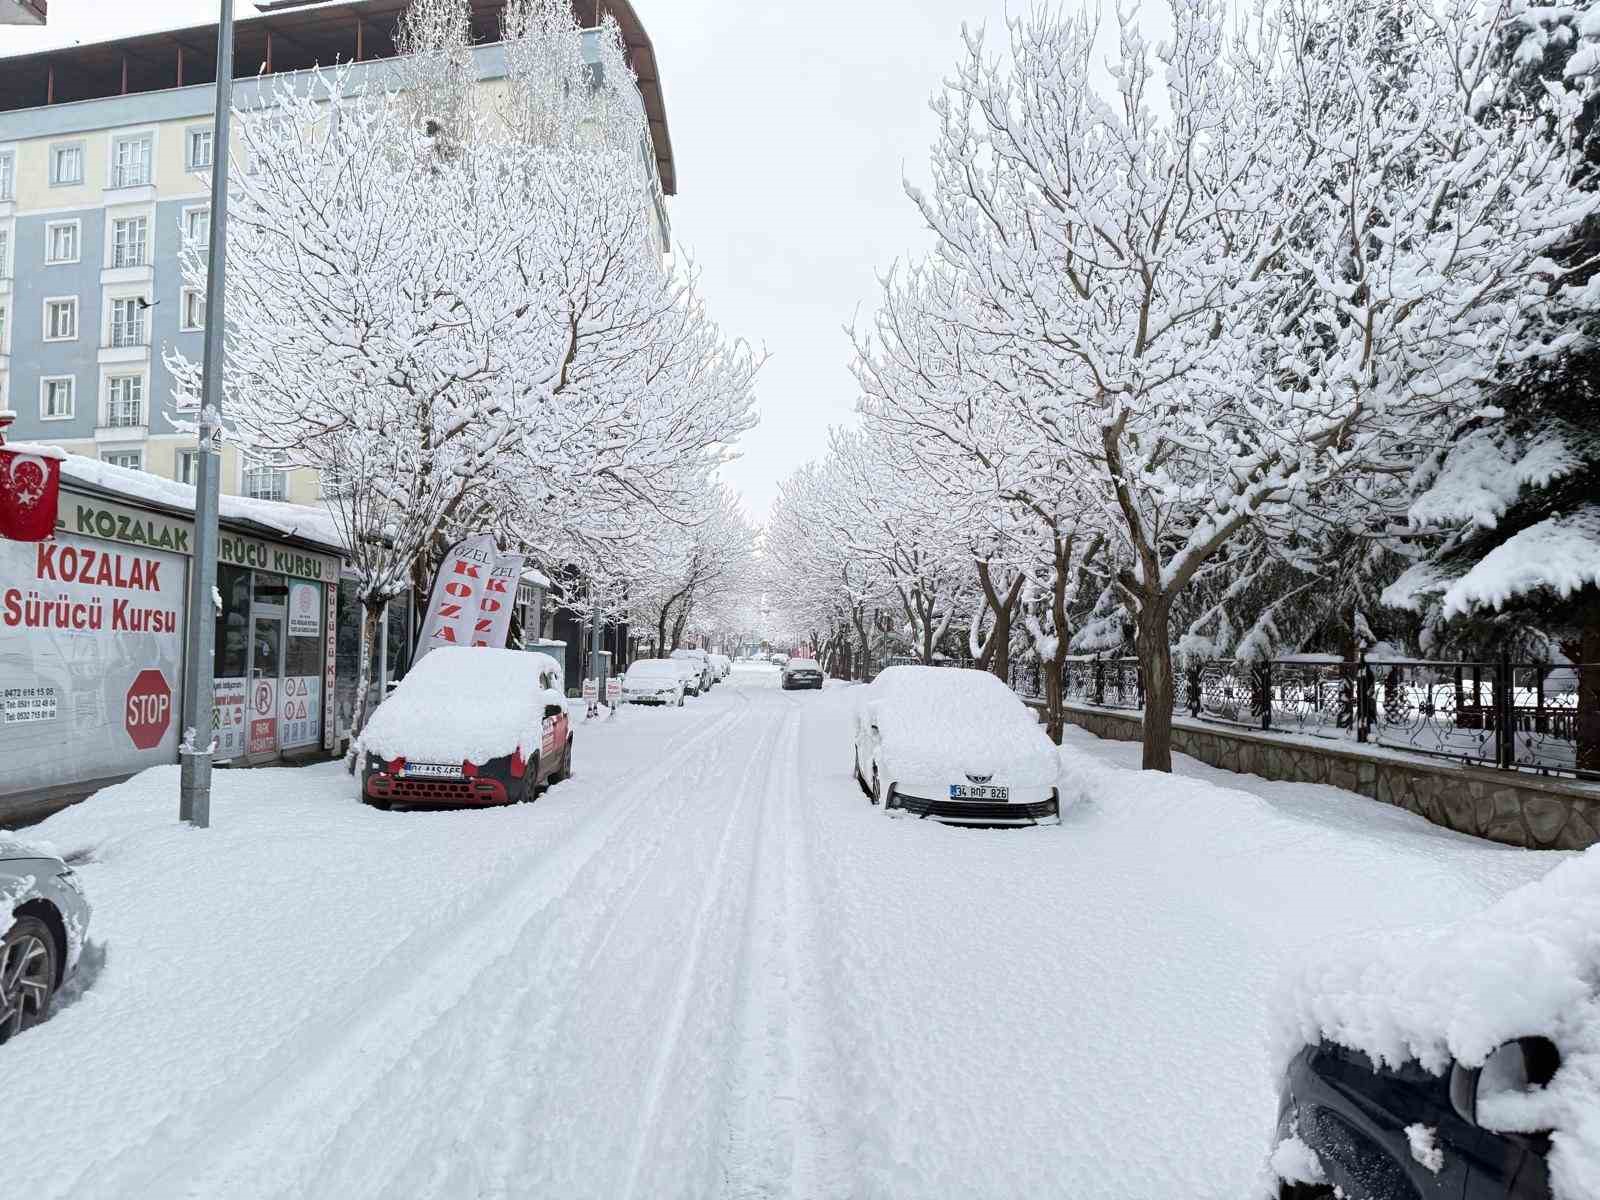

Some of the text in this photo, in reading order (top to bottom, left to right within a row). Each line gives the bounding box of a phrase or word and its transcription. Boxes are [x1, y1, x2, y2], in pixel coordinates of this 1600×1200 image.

[77, 505, 321, 578] KOZALAK RÜCÜ KURSU
[37, 543, 161, 592] KOZALAK
[490, 567, 515, 578] ZEL
[3, 588, 176, 633] Sürücü Kursu
[128, 694, 169, 726] STOP
[957, 787, 967, 797] 34
[991, 788, 1007, 799] 826
